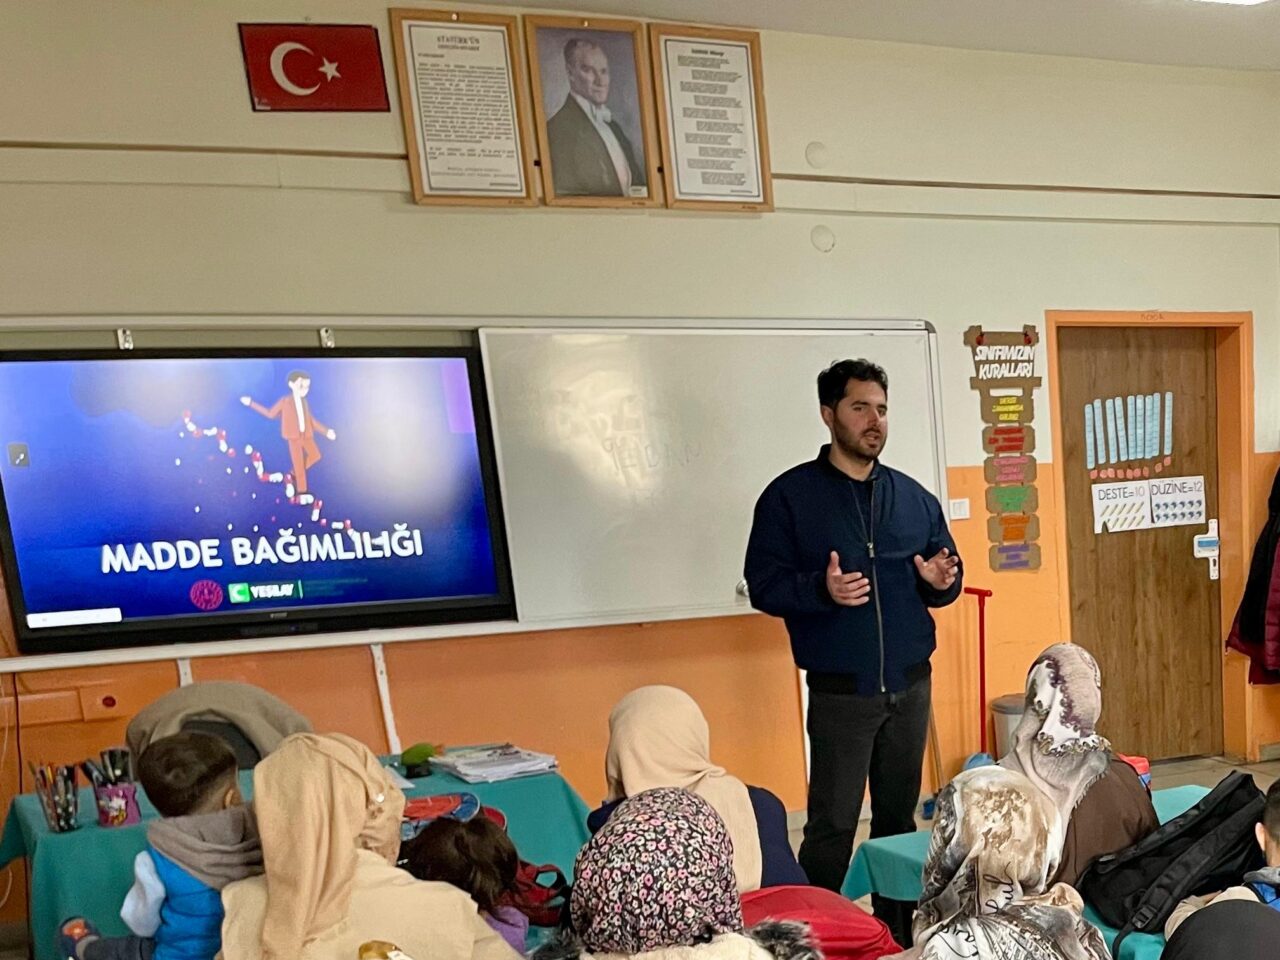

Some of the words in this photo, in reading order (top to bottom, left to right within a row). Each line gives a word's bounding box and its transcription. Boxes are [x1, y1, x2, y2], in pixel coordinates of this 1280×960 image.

[978, 362, 1034, 380] KURALLARI
[1098, 486, 1146, 501] DESTE=10
[101, 537, 223, 573] MADDE
[231, 522, 424, 568] BAĞIMLILIĞI
